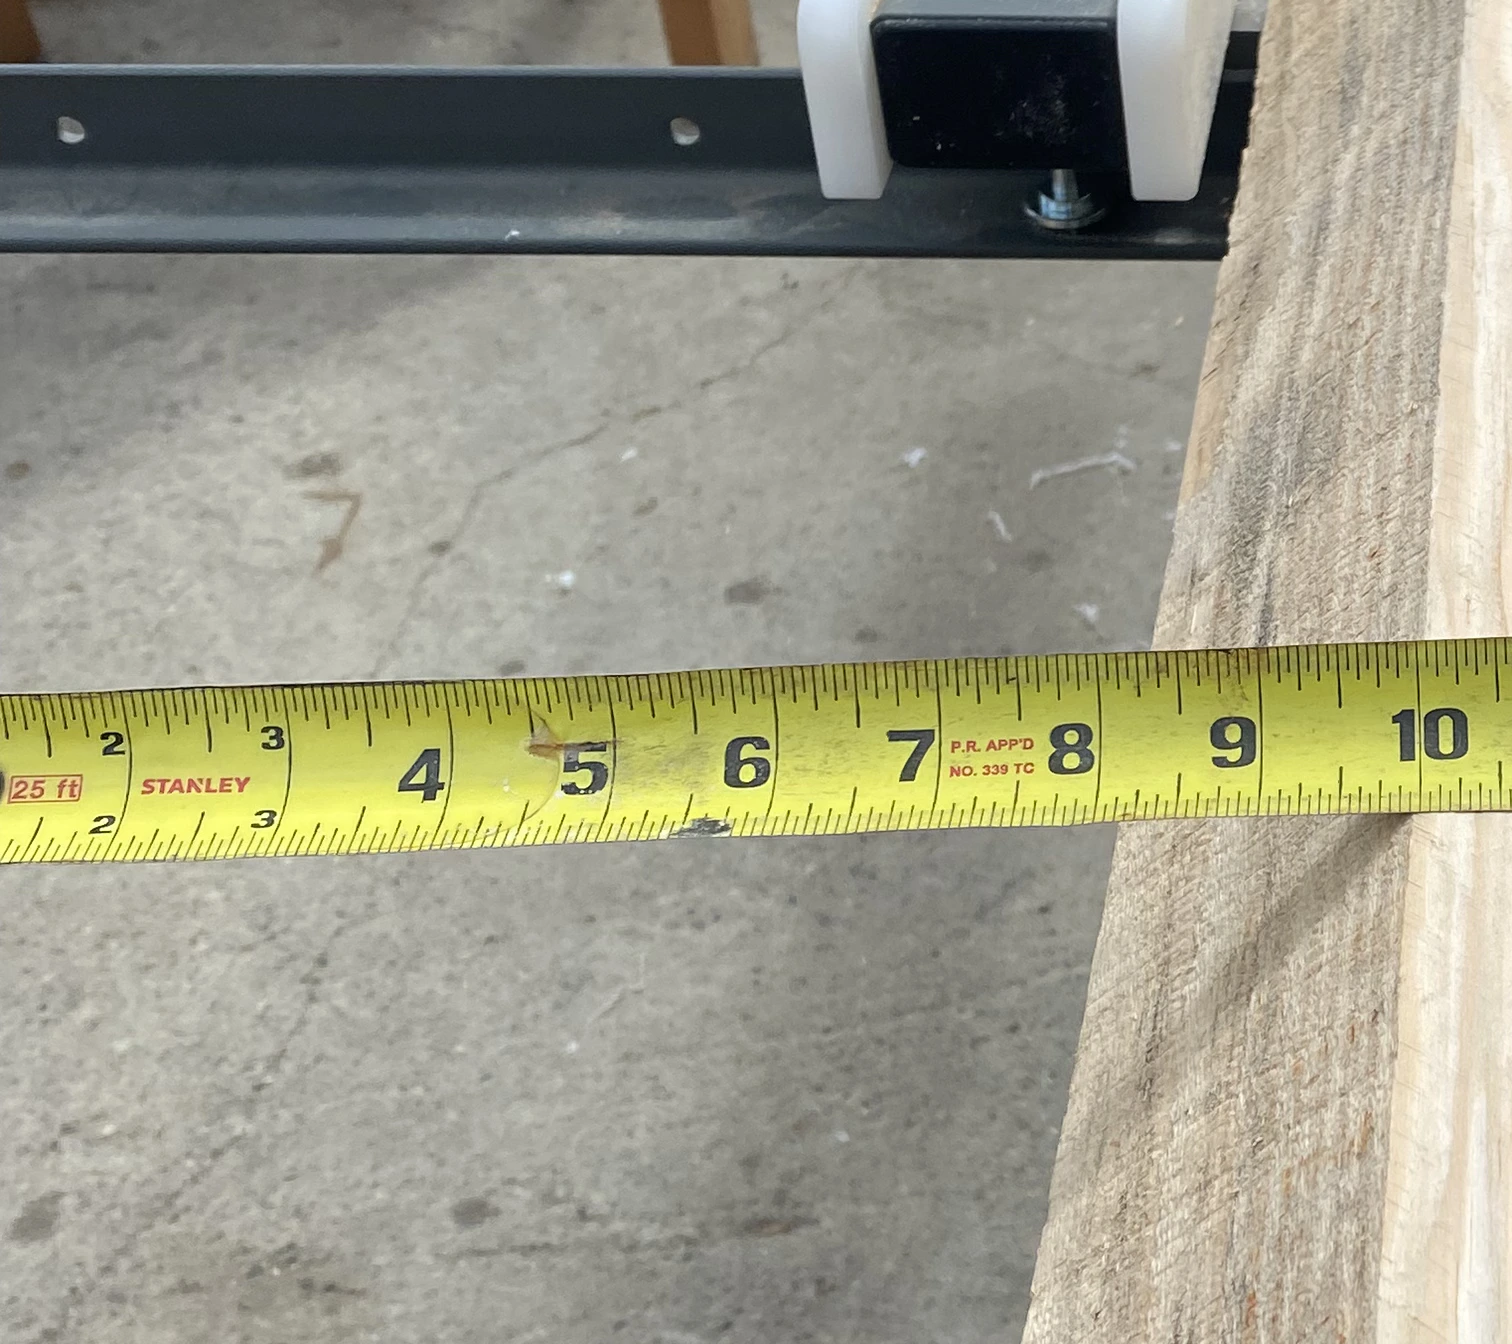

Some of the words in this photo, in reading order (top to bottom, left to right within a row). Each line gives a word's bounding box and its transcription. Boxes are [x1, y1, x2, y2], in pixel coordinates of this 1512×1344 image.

[100, 731, 126, 756] 2
[260, 725, 285, 750] 3
[950, 740, 981, 753] P.R.
[985, 738, 1034, 752] APP'D
[398, 748, 446, 801] 4
[560, 741, 609, 795] 5
[723, 736, 771, 788] 6
[886, 729, 936, 782] 7
[1048, 722, 1095, 775] 8
[1209, 716, 1257, 768] 9
[1391, 708, 1469, 761] 10
[949, 765, 978, 777] NO.
[982, 764, 1008, 776] 339
[1014, 762, 1035, 774] TC
[11, 779, 45, 800] 25
[57, 779, 80, 799] ft
[141, 777, 250, 795] STANLEY
[88, 815, 116, 835] 2
[250, 809, 278, 829] 3
